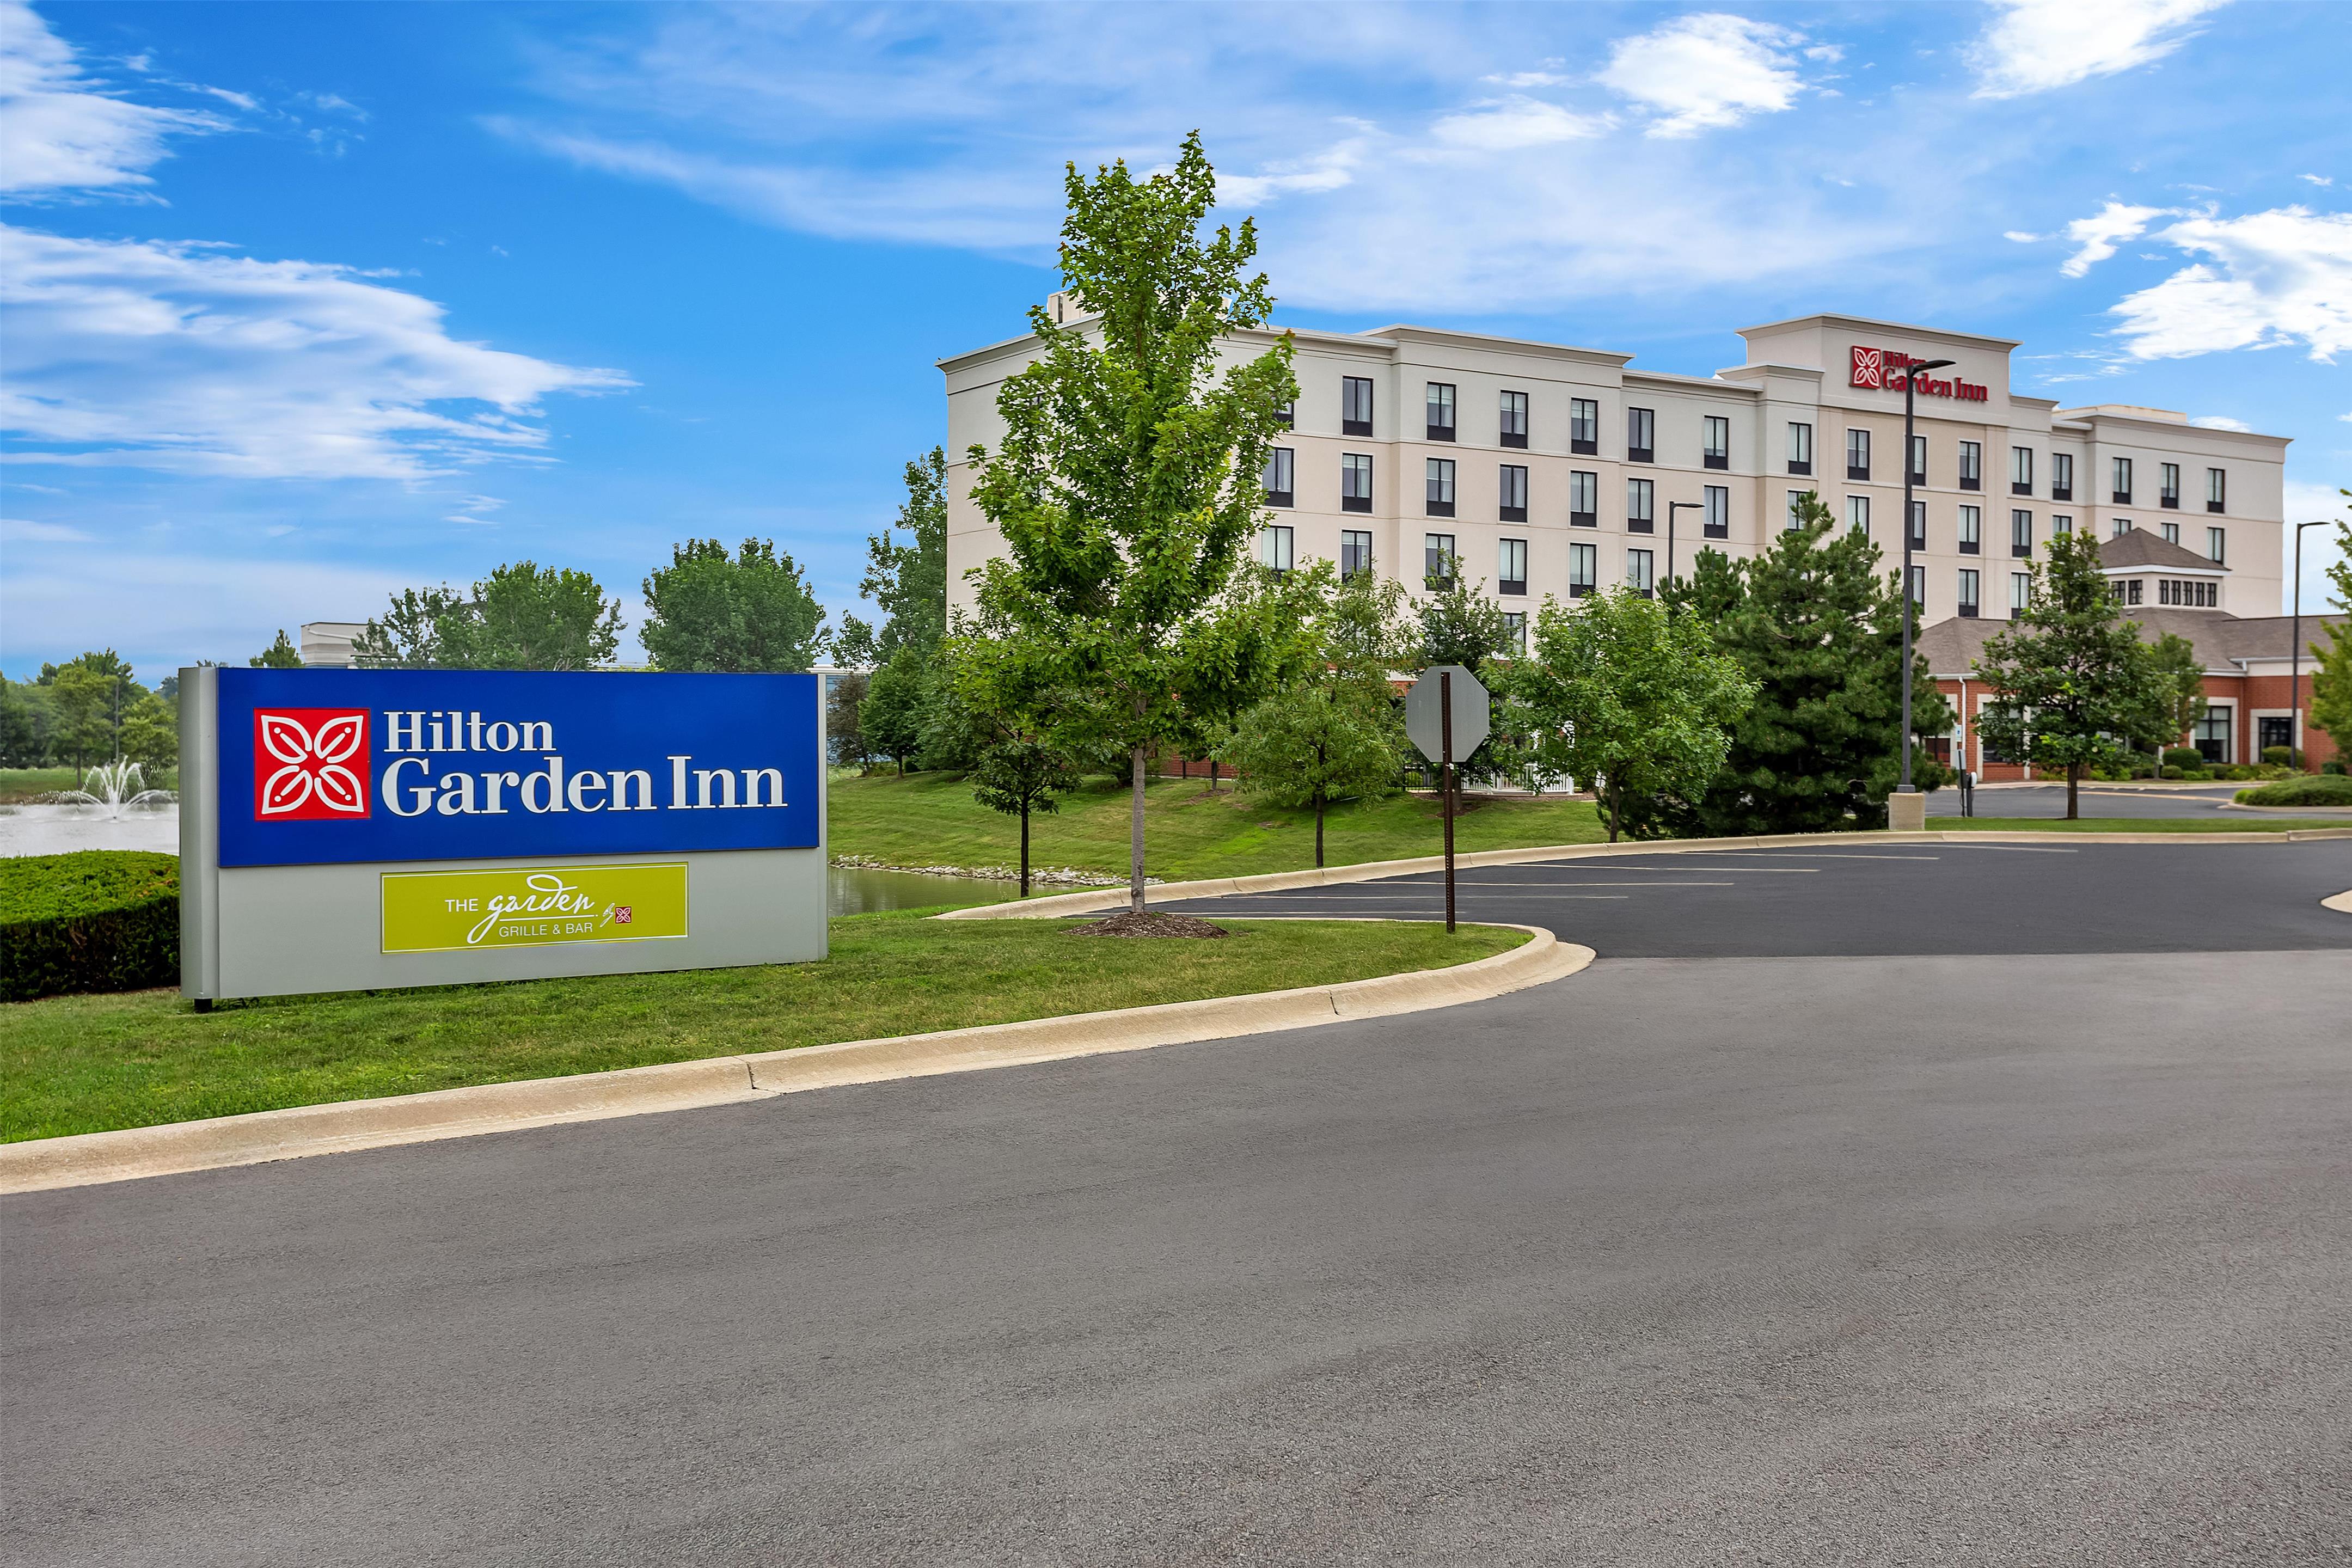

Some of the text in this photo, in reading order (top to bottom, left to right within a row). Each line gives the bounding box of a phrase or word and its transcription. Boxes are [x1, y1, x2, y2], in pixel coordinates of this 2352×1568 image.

[1955, 377, 1988, 401] Inn
[383, 712, 557, 753] Hilton
[382, 755, 789, 817] Garden Inn
[444, 873, 595, 945] THE garden
[498, 921, 593, 938] GRILLE & BAR
